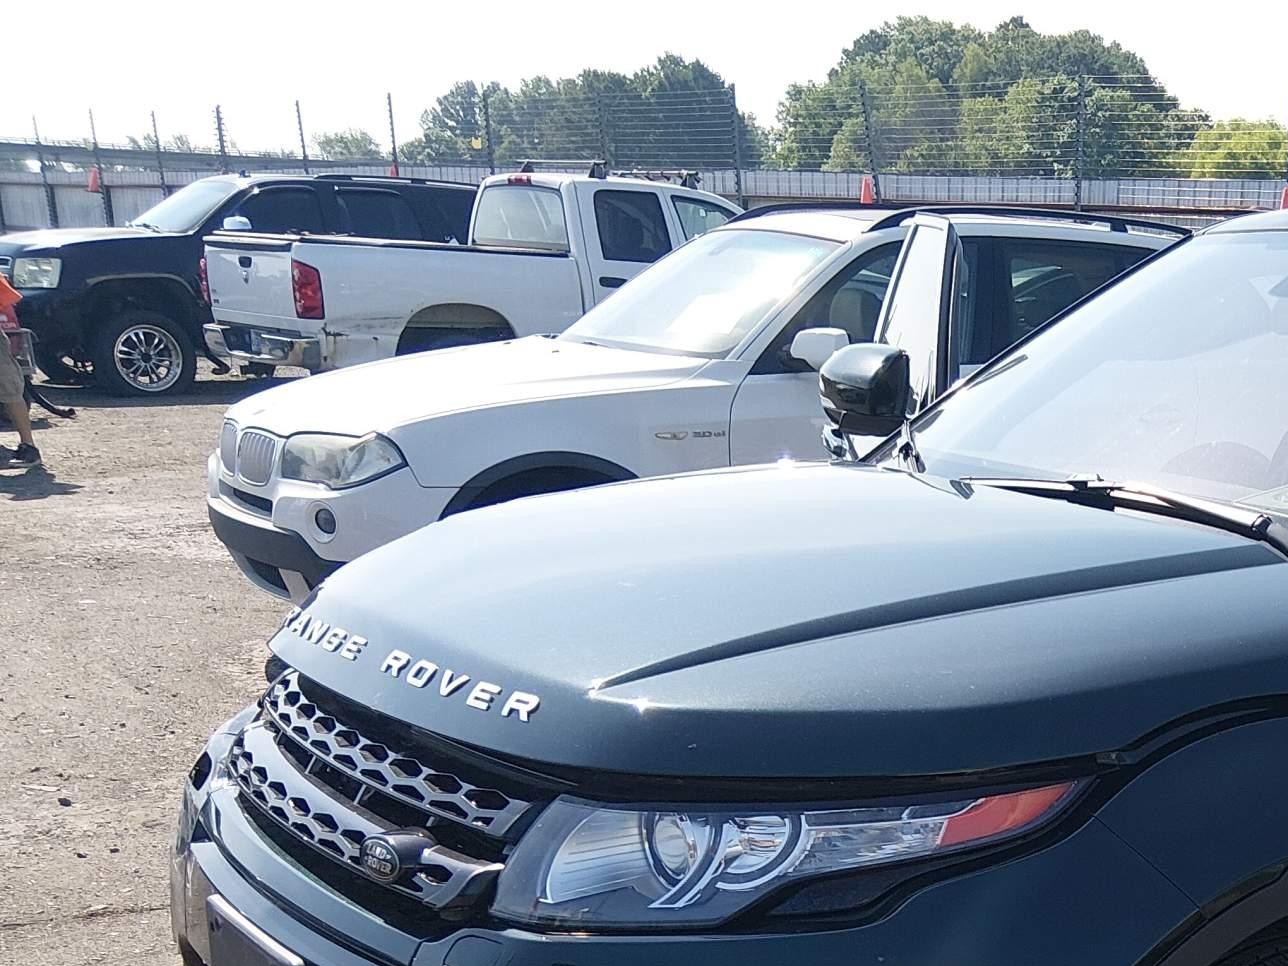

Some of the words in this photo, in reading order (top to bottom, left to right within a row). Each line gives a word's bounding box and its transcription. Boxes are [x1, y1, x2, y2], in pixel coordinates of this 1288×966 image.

[380, 648, 541, 722] ROVER
[366, 843, 388, 860] LAND
[367, 855, 393, 875] ROVER
